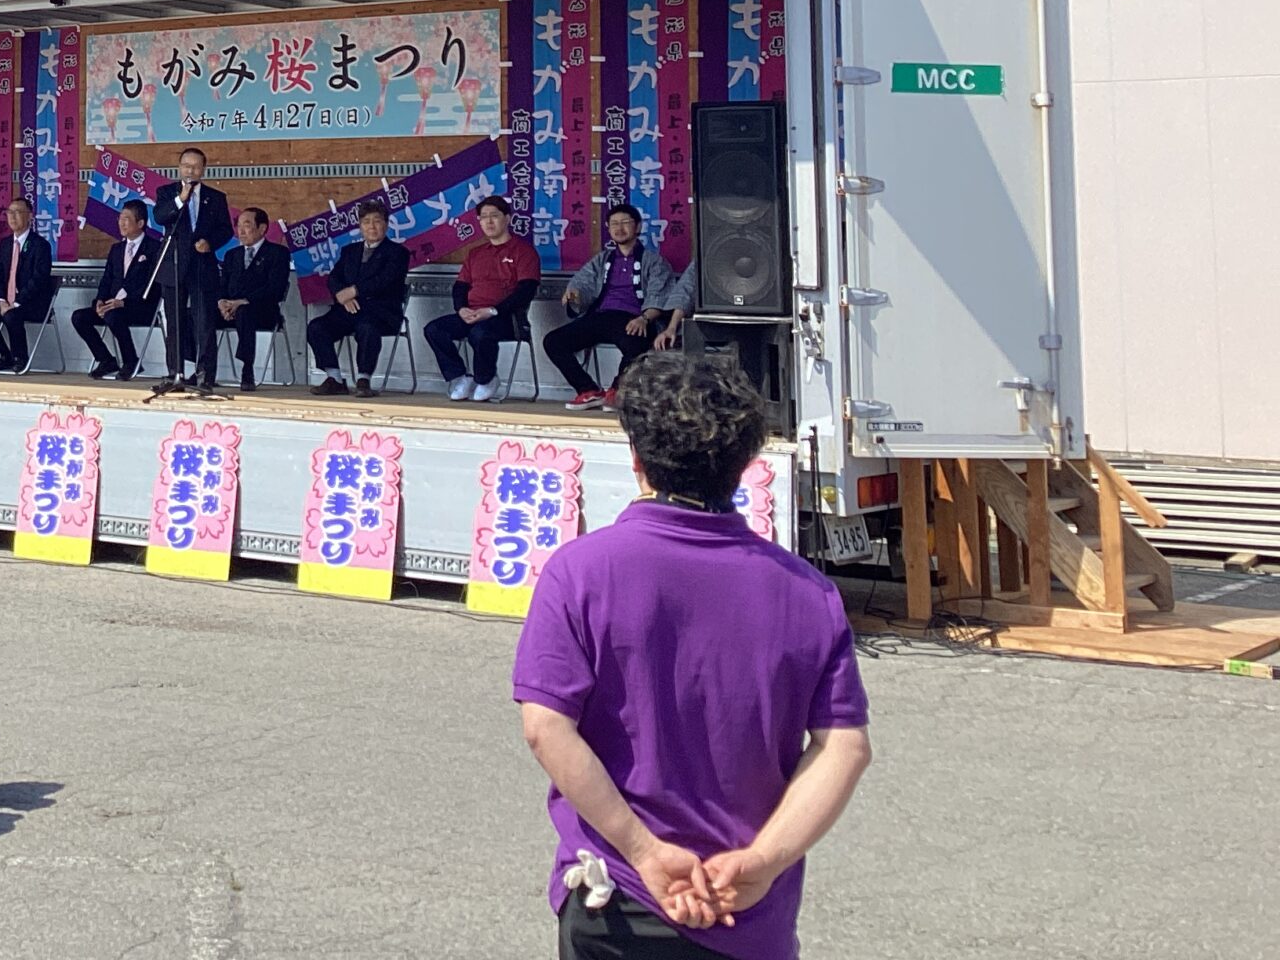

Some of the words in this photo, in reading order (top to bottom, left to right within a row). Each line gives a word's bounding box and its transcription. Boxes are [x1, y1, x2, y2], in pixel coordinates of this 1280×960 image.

[0, 37, 12, 94] 山形県
[63, 32, 77, 89] 山形県
[117, 26, 469, 100] もがみ桜まつり
[917, 68, 976, 90] MCC
[35, 44, 64, 241] もがみ南部
[181, 103, 372, 133] 令和7年4月27日(日)
[532, 9, 570, 246] もがみ南部
[32, 435, 67, 535] 桜まつり
[64, 436, 84, 501] もがみ
[167, 444, 203, 548] 桜まつり
[201, 446, 222, 514] もがみ
[360, 456, 382, 528] もがみ
[320, 454, 362, 565] 桜まつり
[492, 467, 538, 586] 桜まつり
[535, 470, 563, 548] もがみ
